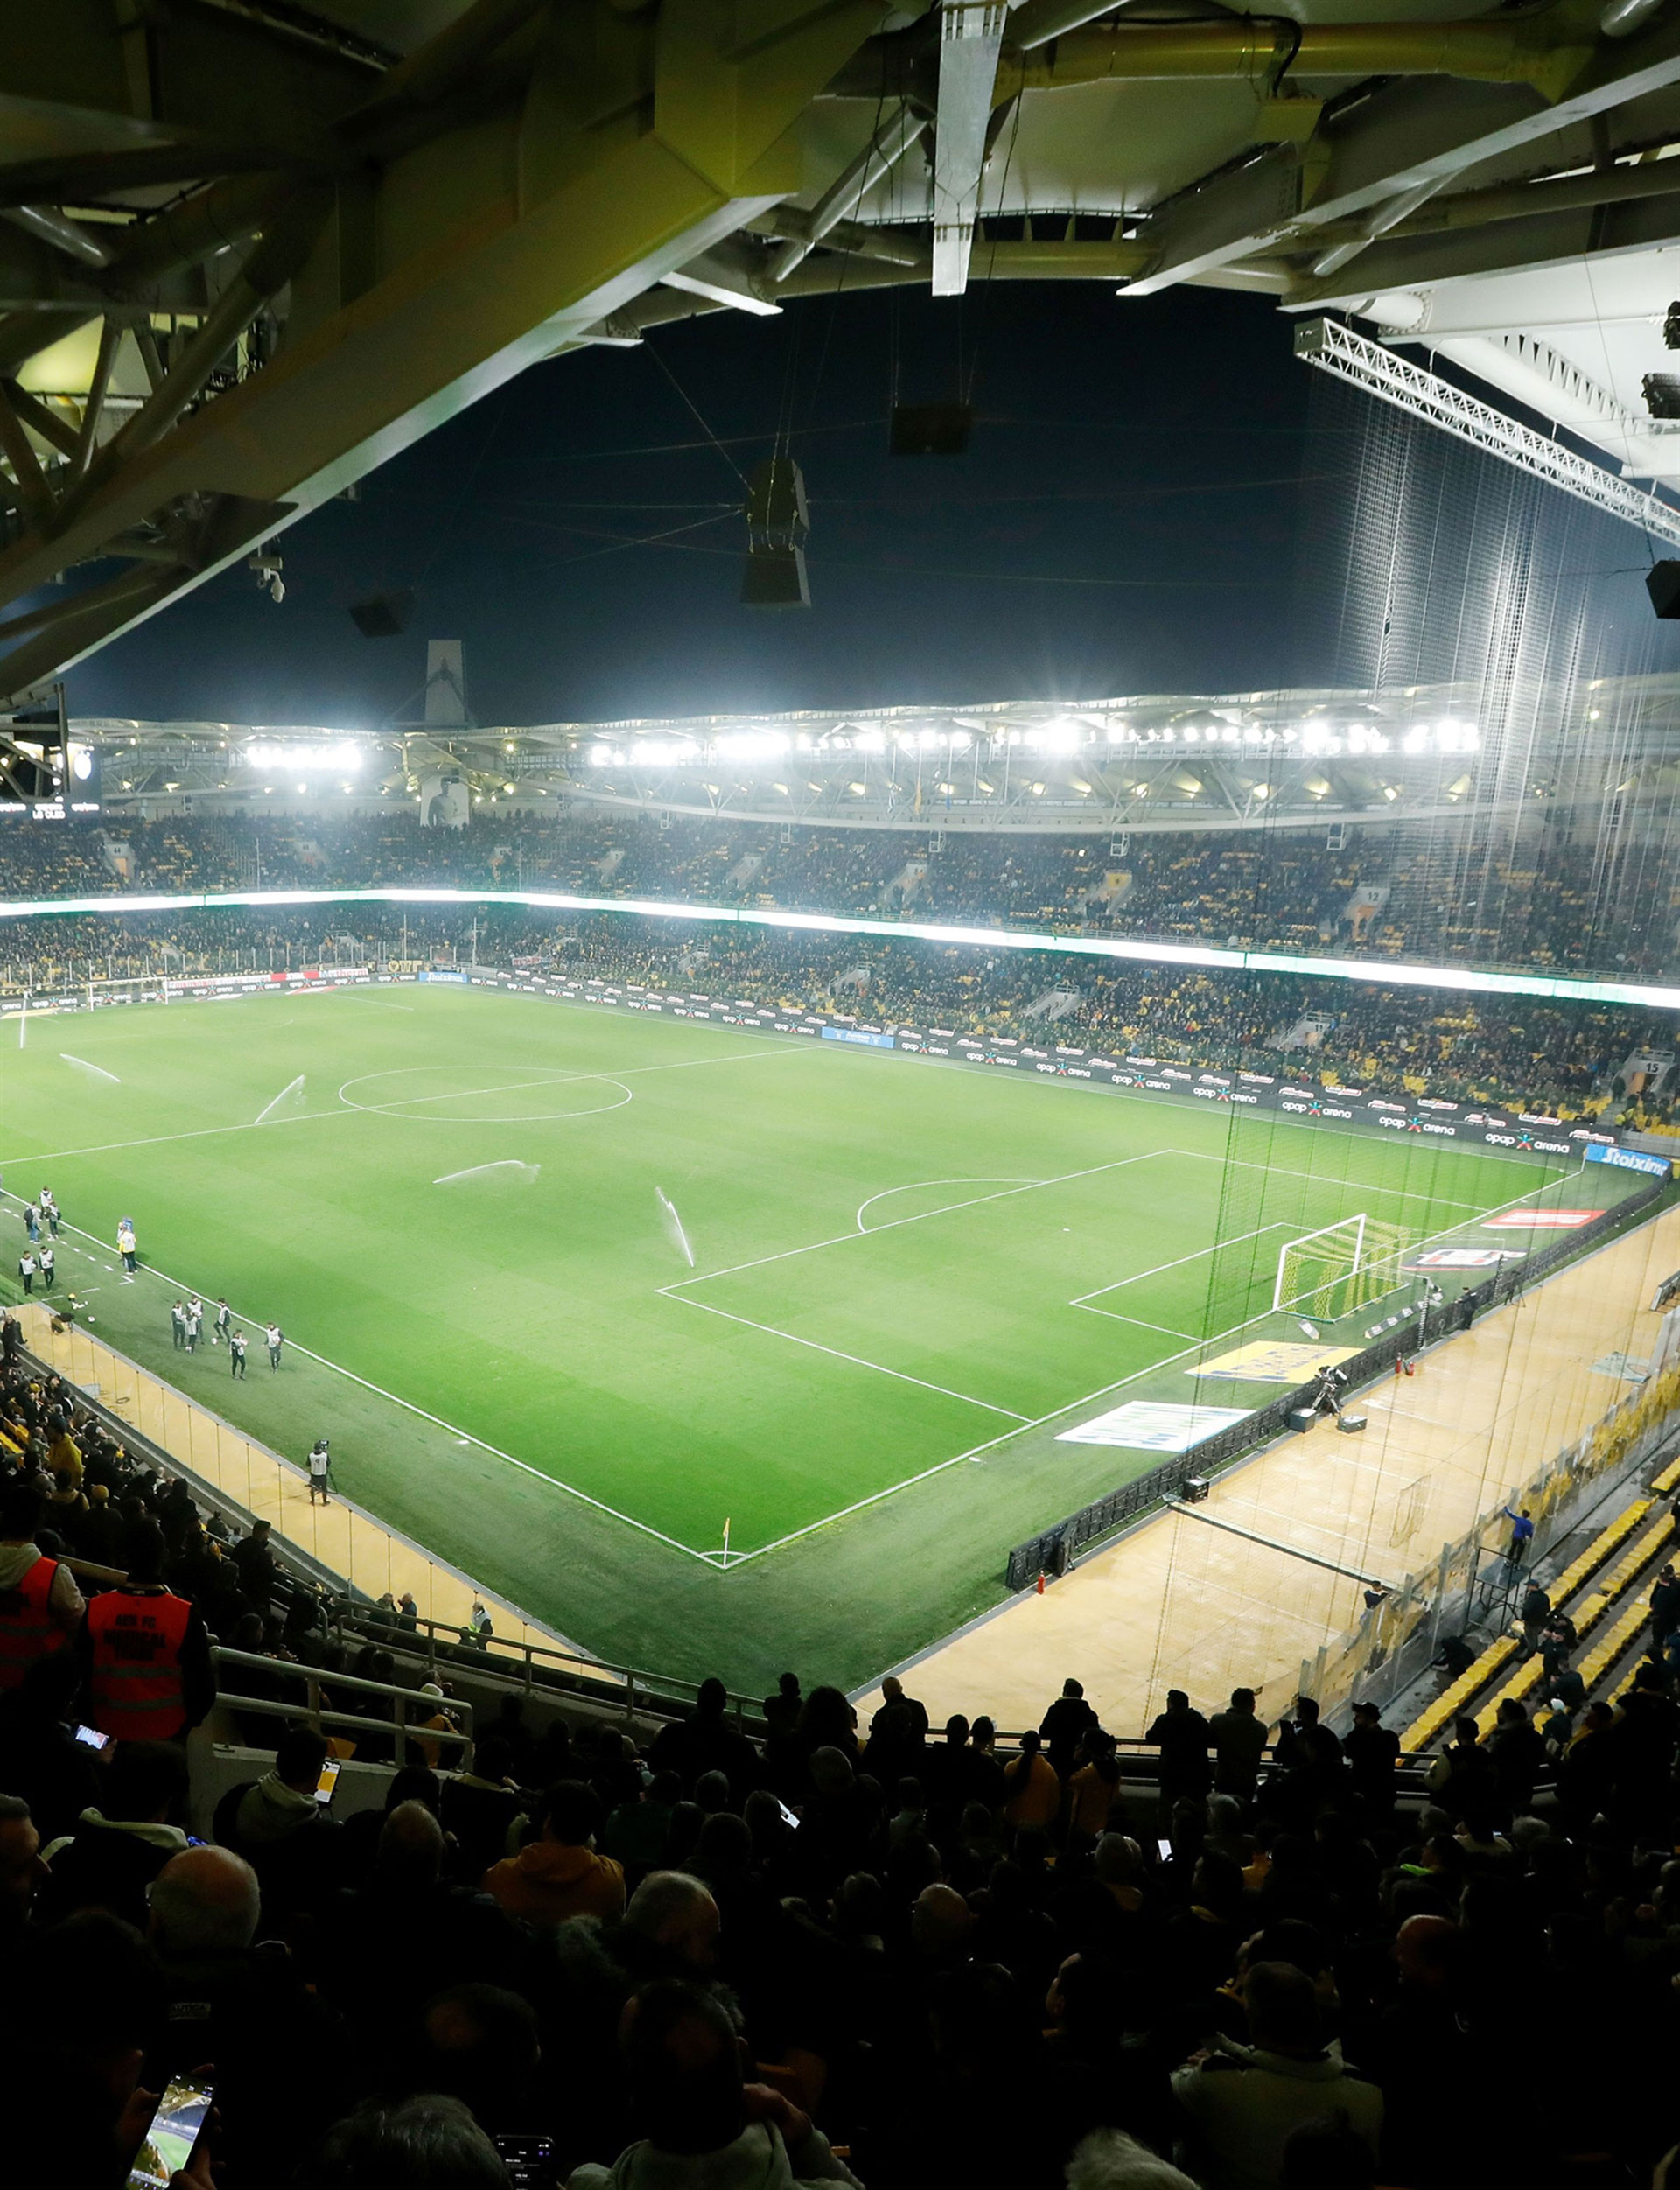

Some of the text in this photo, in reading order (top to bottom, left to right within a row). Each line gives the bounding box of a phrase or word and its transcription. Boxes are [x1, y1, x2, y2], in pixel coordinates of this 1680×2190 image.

[1368, 892, 1379, 901] 12
[967, 1053, 984, 1061] opap
[1037, 1063, 1090, 1077] opap arena
[1646, 1062, 1659, 1073] 15
[1112, 1075, 1170, 1089] opap arena
[1194, 1088, 1257, 1103] opap arena
[1283, 1102, 1351, 1118] opap arena
[1379, 1117, 1455, 1135] opap arena
[1486, 1134, 1570, 1152] opap arena
[142, 1615, 157, 1628] FC
